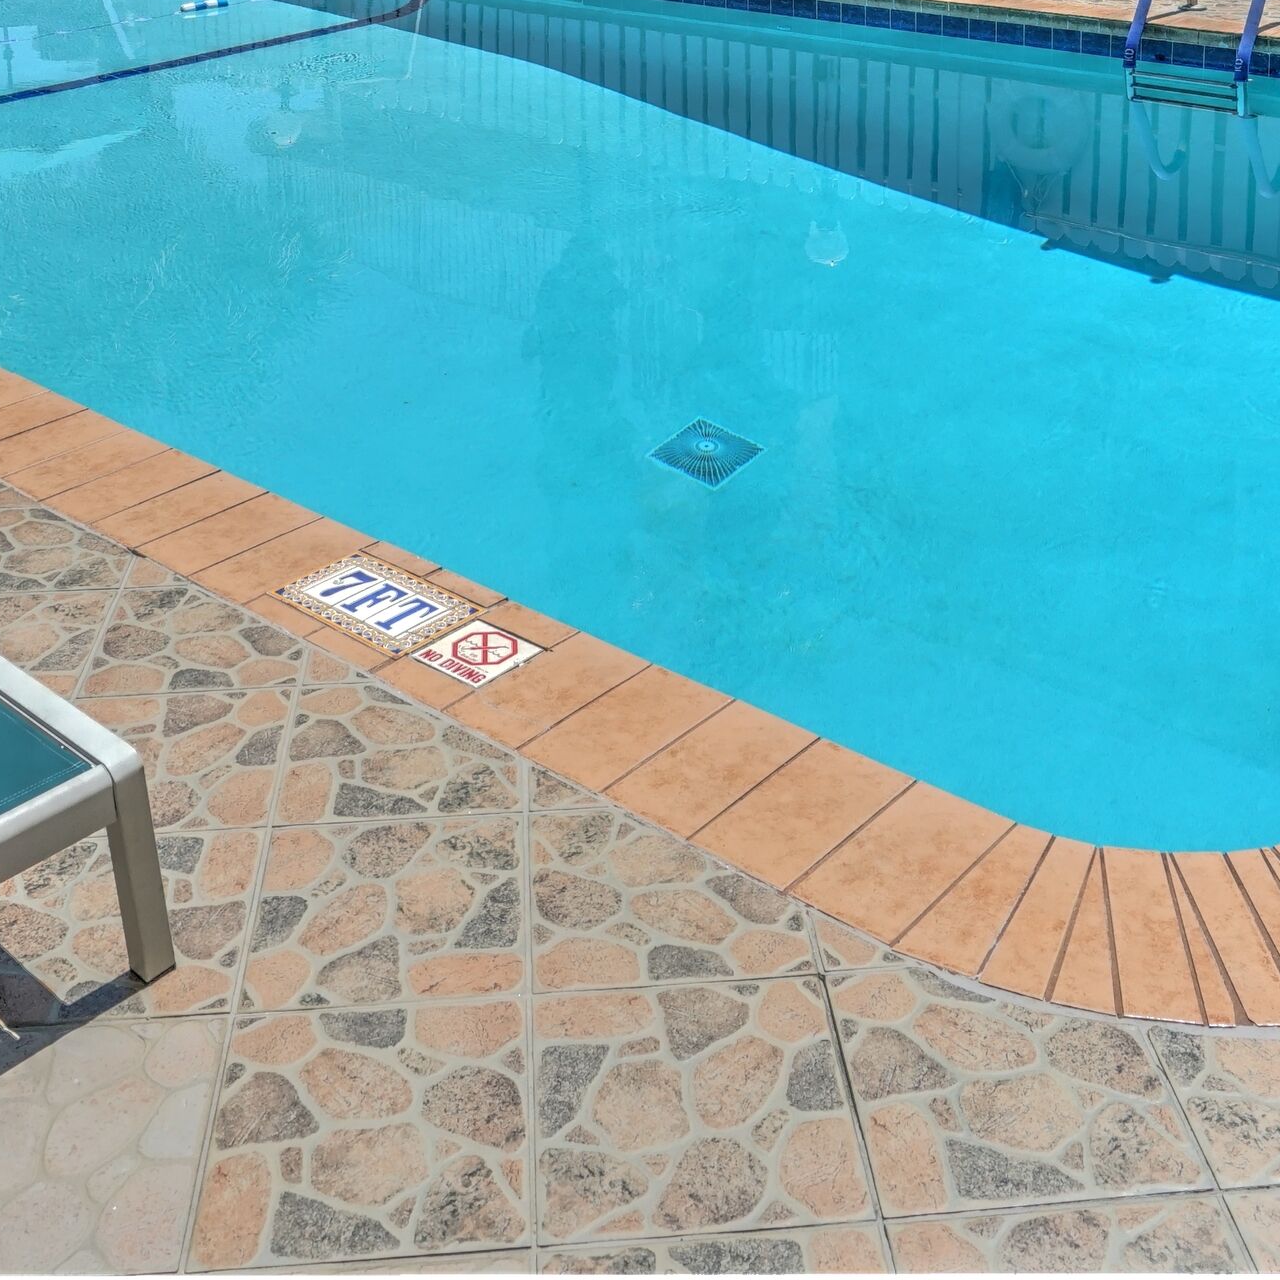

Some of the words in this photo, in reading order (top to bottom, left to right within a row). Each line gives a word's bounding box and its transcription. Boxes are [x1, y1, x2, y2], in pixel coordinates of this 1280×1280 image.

[319, 570, 439, 630] 7FT
[419, 649, 453, 662] NO
[439, 658, 487, 684] DIVING
